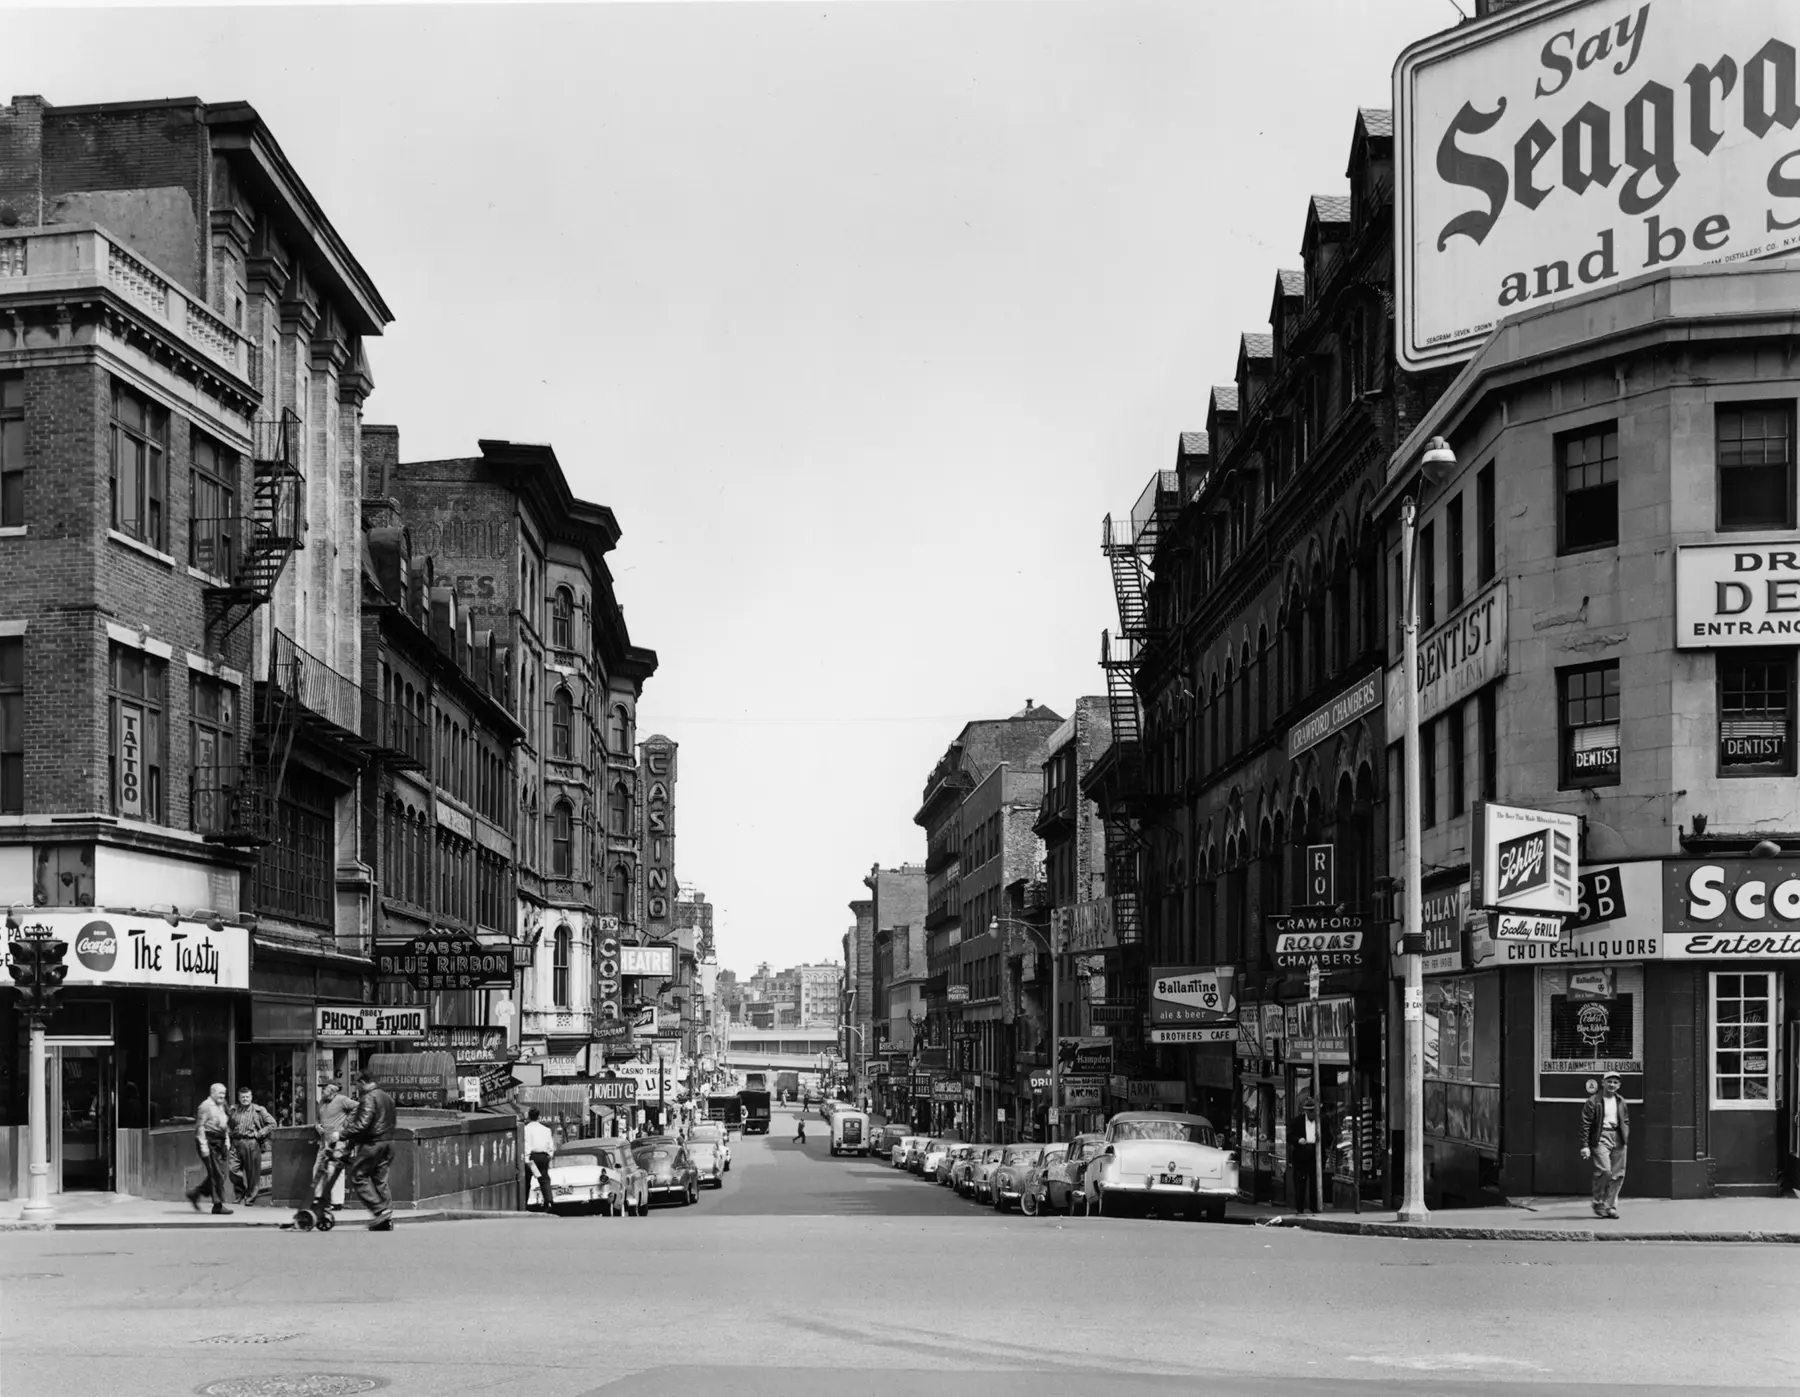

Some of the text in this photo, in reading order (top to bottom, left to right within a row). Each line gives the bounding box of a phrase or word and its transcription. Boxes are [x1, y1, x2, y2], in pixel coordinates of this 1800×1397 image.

[1535, 3, 1651, 99] Say
[1498, 229, 1618, 306] and
[1642, 213, 1730, 267] be
[1725, 247, 1762, 263] DISTILLERS
[1426, 333, 1451, 344] SEAGRAM
[1454, 328, 1470, 337] SEVEN
[1417, 596, 1495, 693] DENTIST
[1293, 680, 1375, 750] CRAWFORD CHAMBERS
[1728, 739, 1780, 755] DENTIST
[123, 715, 138, 803] TATTOO
[1576, 749, 1618, 767] DENTIST
[647, 752, 668, 918] CASINO
[1500, 836, 1544, 891] Schlitz
[1422, 893, 1458, 922] OLLAY
[1276, 917, 1362, 930] CRAWFORD
[1500, 918, 1558, 940] Scollay GRILL
[1283, 934, 1356, 951] ROOMS
[1423, 926, 1452, 951] RILL
[128, 929, 219, 984] The Tasty
[414, 942, 473, 954] PABST
[1508, 938, 1657, 960] CHOICE LIQUORS
[380, 955, 508, 974] BLUE RIBBON
[621, 951, 670, 972] HEATRE
[1277, 953, 1363, 967] CHAMBERS
[417, 975, 472, 988] BEER
[1157, 979, 1217, 994] Ballantine
[321, 1010, 421, 1030] PHOTO STUDIO
[360, 1009, 383, 1017] ABBEY
[1160, 1009, 1206, 1019] ale & beer
[593, 1026, 626, 1038] RESTAURANT
[1160, 1031, 1230, 1041] BROTHERS CAFE
[621, 1067, 672, 1075] CASINO THEARE
[1543, 1061, 1641, 1071] ENTERTAINMENT TELEVISION
[407, 1091, 438, 1100] DANCE
[594, 1083, 624, 1099] NOVELTY
